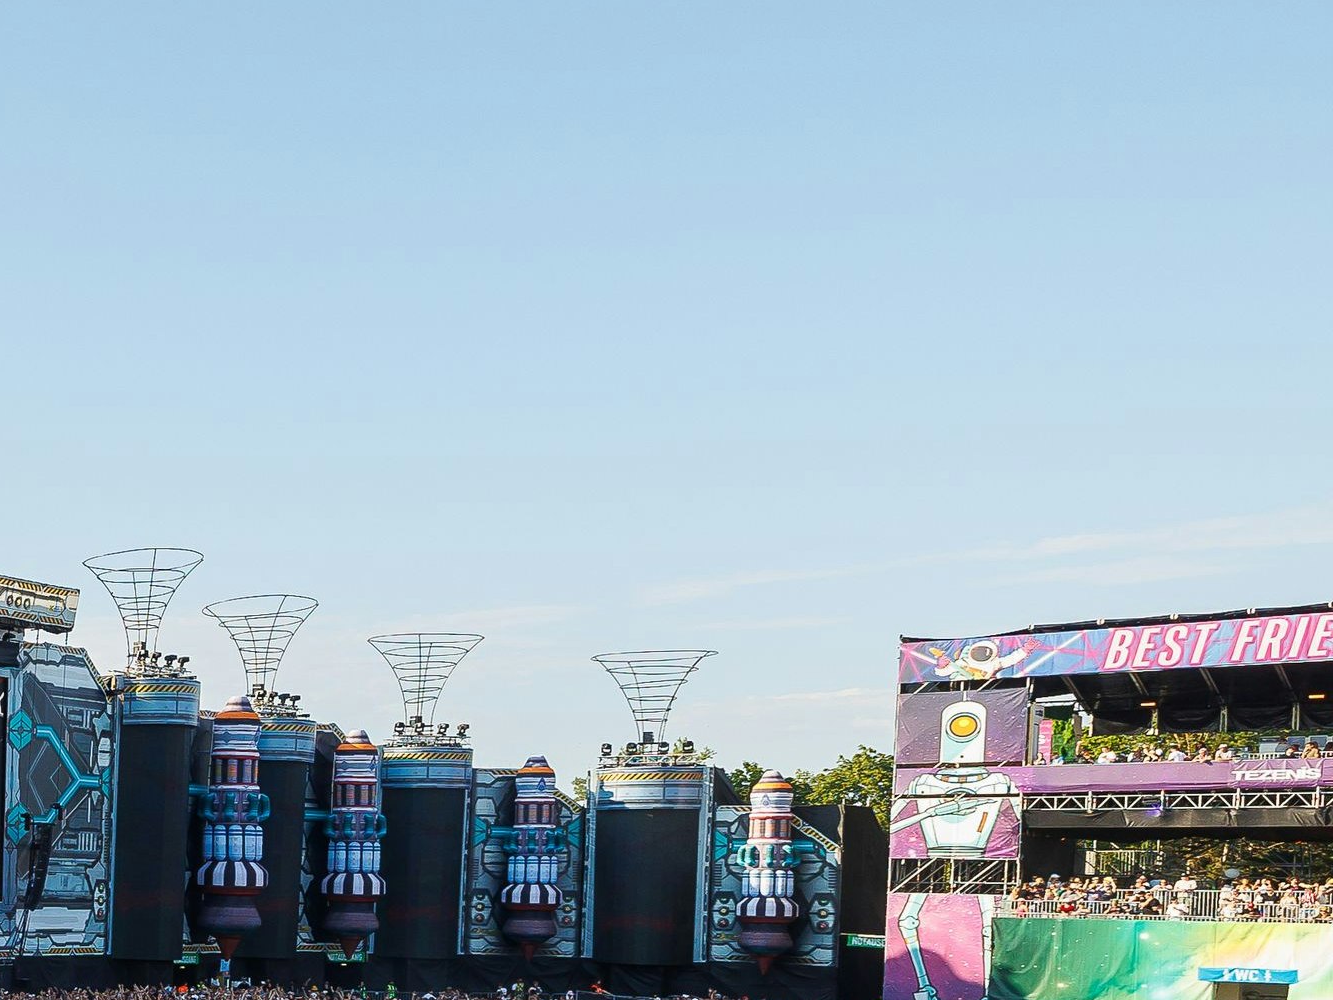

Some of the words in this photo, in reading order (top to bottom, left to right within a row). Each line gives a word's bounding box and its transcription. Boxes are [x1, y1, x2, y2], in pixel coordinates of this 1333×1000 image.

[1103, 622, 1220, 670] BEST
[1229, 614, 1333, 662] FRIE
[1231, 767, 1321, 782] TEZENIS
[1234, 968, 1259, 981] WC
